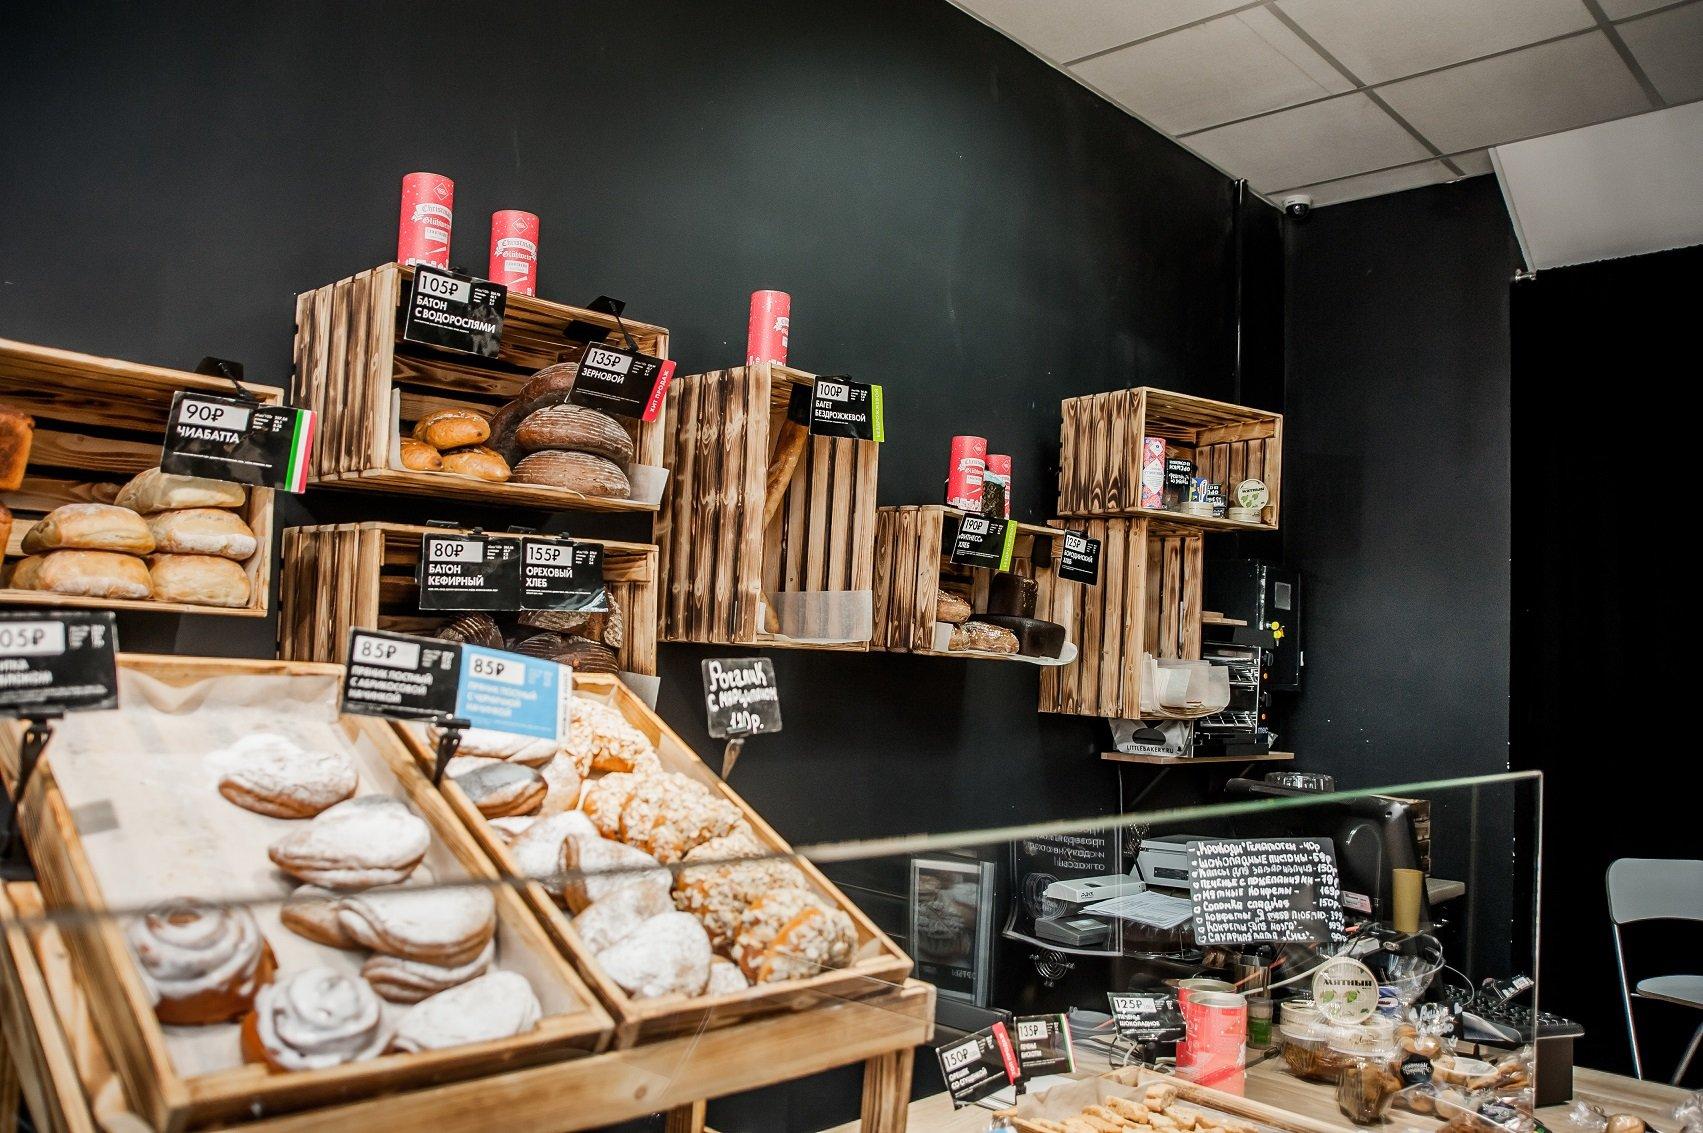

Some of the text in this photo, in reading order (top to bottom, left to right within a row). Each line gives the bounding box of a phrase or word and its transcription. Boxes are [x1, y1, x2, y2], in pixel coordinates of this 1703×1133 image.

[421, 276, 459, 296] 105₽
[417, 295, 448, 311] БАТОН
[415, 308, 422, 317] С
[422, 310, 496, 333] ВОДОРОСЛЯМИ
[591, 351, 621, 368] 135₽
[582, 368, 625, 384] ЗЕРНОВОЙ
[650, 370, 670, 413] ХИТ ПРОДАЖ
[816, 400, 833, 409] БАГЕТ
[186, 404, 224, 421] 90₽
[815, 409, 866, 422] БЕЗДРОЖЖЕВОЙ
[176, 425, 240, 444] ЧИАБАТТА
[434, 543, 464, 557] 80₽
[529, 547, 561, 561] 155₽
[429, 564, 461, 574] БАТОН
[526, 566, 573, 578] ОРЕХОВЫЙ
[428, 574, 484, 586] КЕФИРНЫЙ
[526, 578, 547, 588] ХЛЕБ
